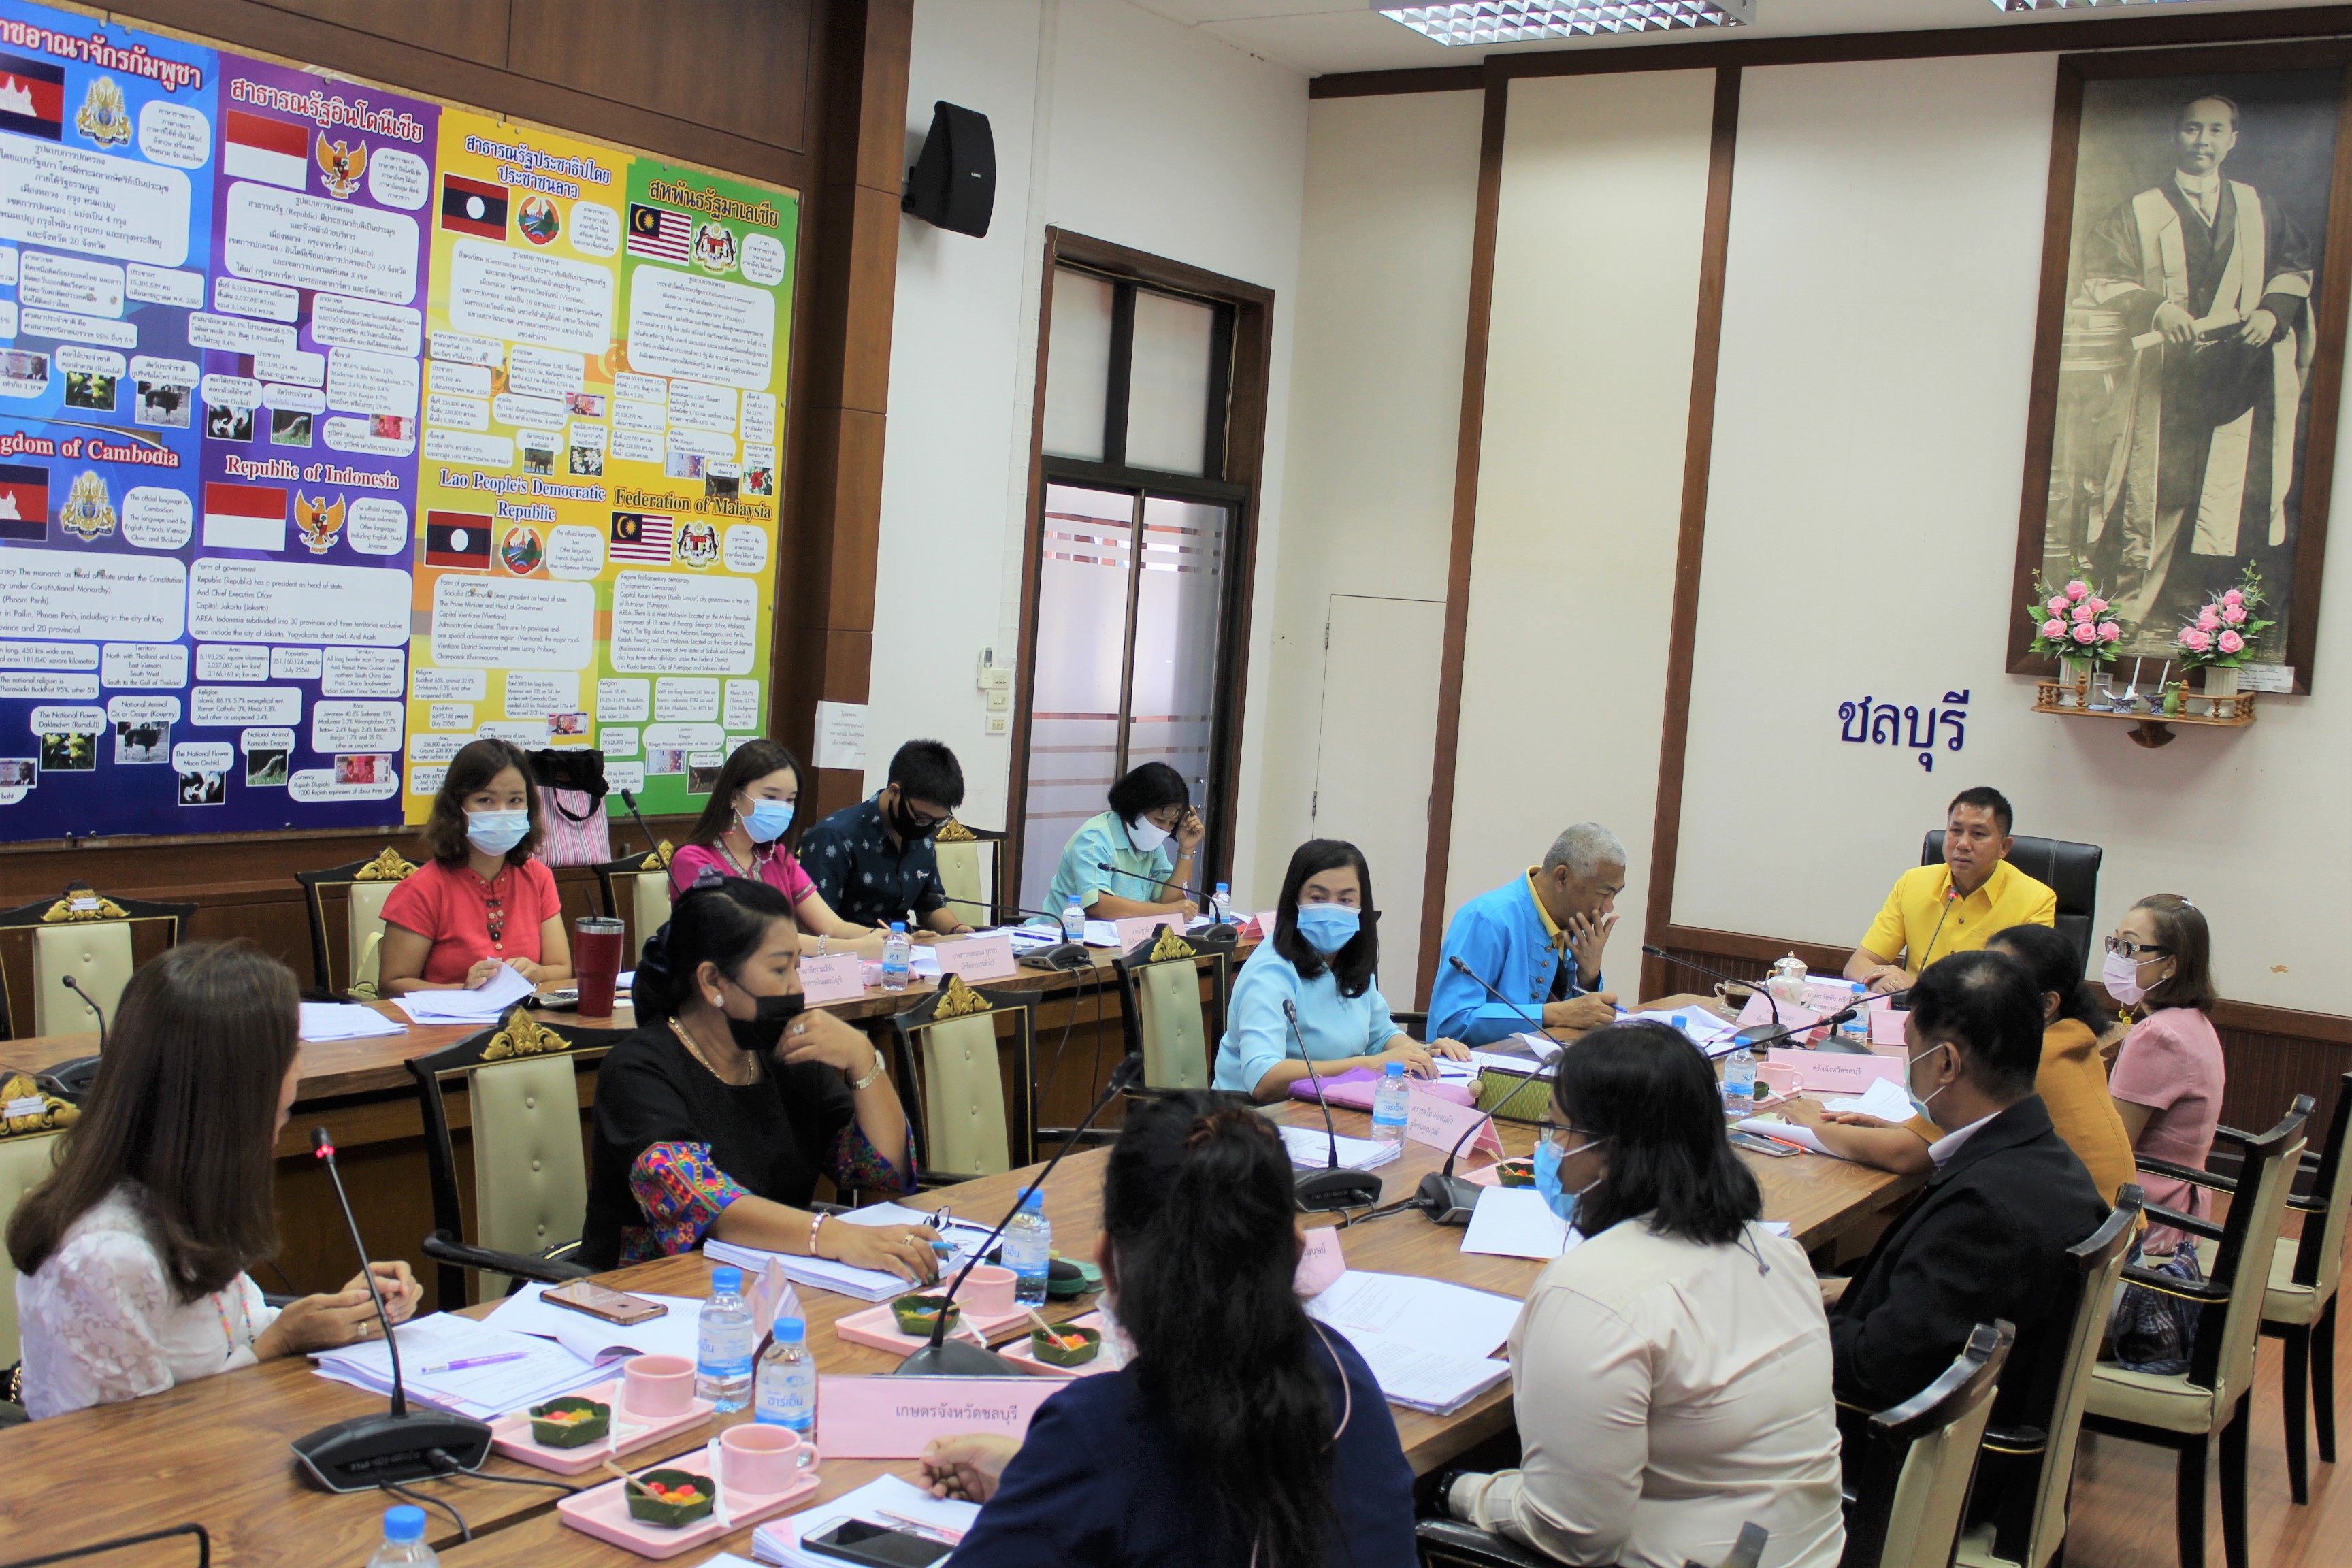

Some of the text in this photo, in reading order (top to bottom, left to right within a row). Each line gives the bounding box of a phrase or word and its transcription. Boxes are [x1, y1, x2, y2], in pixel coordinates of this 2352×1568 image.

[230, 78, 424, 142] สาธารณรัฐอินโดนีเซีย
[35, 145, 105, 165] รูปแบบการปกครอง
[466, 135, 610, 184] สาธารณรัฐประชาธิปไตย
[35, 173, 99, 194] ภายใต้รัฐธรรมนูญ
[498, 166, 578, 199] ประชาชนลาว
[21, 184, 116, 211] เมืองหลวง กรุง พนมเปญ
[295, 197, 353, 214] รูปแบบการปกครอง
[650, 180, 779, 228] สหพันธรัฐมาเลเซีย
[7, 197, 66, 215] เขตการปกครอง
[74, 208, 103, 221] แบ่งเป็น
[113, 217, 127, 227] กรุง
[248, 200, 283, 216] สาธารณรัฐ
[286, 208, 318, 220] (Republic)
[27, 230, 106, 250] และจังหวัด 20 จังหวัด
[270, 230, 301, 244] เมืองหลวง
[349, 246, 374, 257] (Jakarta)
[61, 438, 82, 457] of
[88, 440, 180, 467] Cambodia
[226, 455, 399, 489] Republic of Indonesia
[440, 468, 606, 501] Lao People's Democratic
[159, 497, 182, 505] language
[614, 487, 772, 522] Federation of Malaysia
[141, 514, 165, 524] language
[180, 517, 186, 525] by
[497, 500, 557, 523] Republic
[148, 535, 159, 543] and
[198, 563, 213, 571] Form
[223, 565, 256, 574] government
[31, 583, 74, 592] Constitutional
[77, 585, 112, 594] Monarchy).
[197, 576, 222, 585] Republic
[224, 577, 252, 586] (Republic)
[272, 579, 297, 589] president
[307, 581, 321, 589] head
[323, 581, 329, 589] of
[3, 595, 50, 605] (Phnom Penh).
[197, 589, 209, 597] And
[211, 589, 227, 598] Chief
[229, 590, 255, 599] Executive
[196, 602, 218, 611] Capital:
[220, 602, 242, 610] Jakarta
[516, 604, 543, 612] Government
[14, 610, 34, 619] Pailin,
[36, 610, 59, 619] Phnom
[61, 612, 78, 621] Penh,
[80, 612, 109, 622] including
[131, 615, 142, 623] city
[246, 617, 276, 625] subdivided
[299, 619, 325, 628] provinces
[150, 710, 177, 719] (Kouprey)
[1838, 689, 1969, 772] ชลบุรี
[271, 740, 289, 749] Dragon
[1807, 992, 1837, 1002] นยธวัชชัย
[1812, 1064, 1861, 1075] คลังจังหวัดชลบุรี
[1382, 1102, 1404, 1111] อาร์เอ็น
[768, 1393, 803, 1407] อาร์เอ็น
[896, 1401, 1018, 1425] เกษตรจังหวัดชลบุรี
